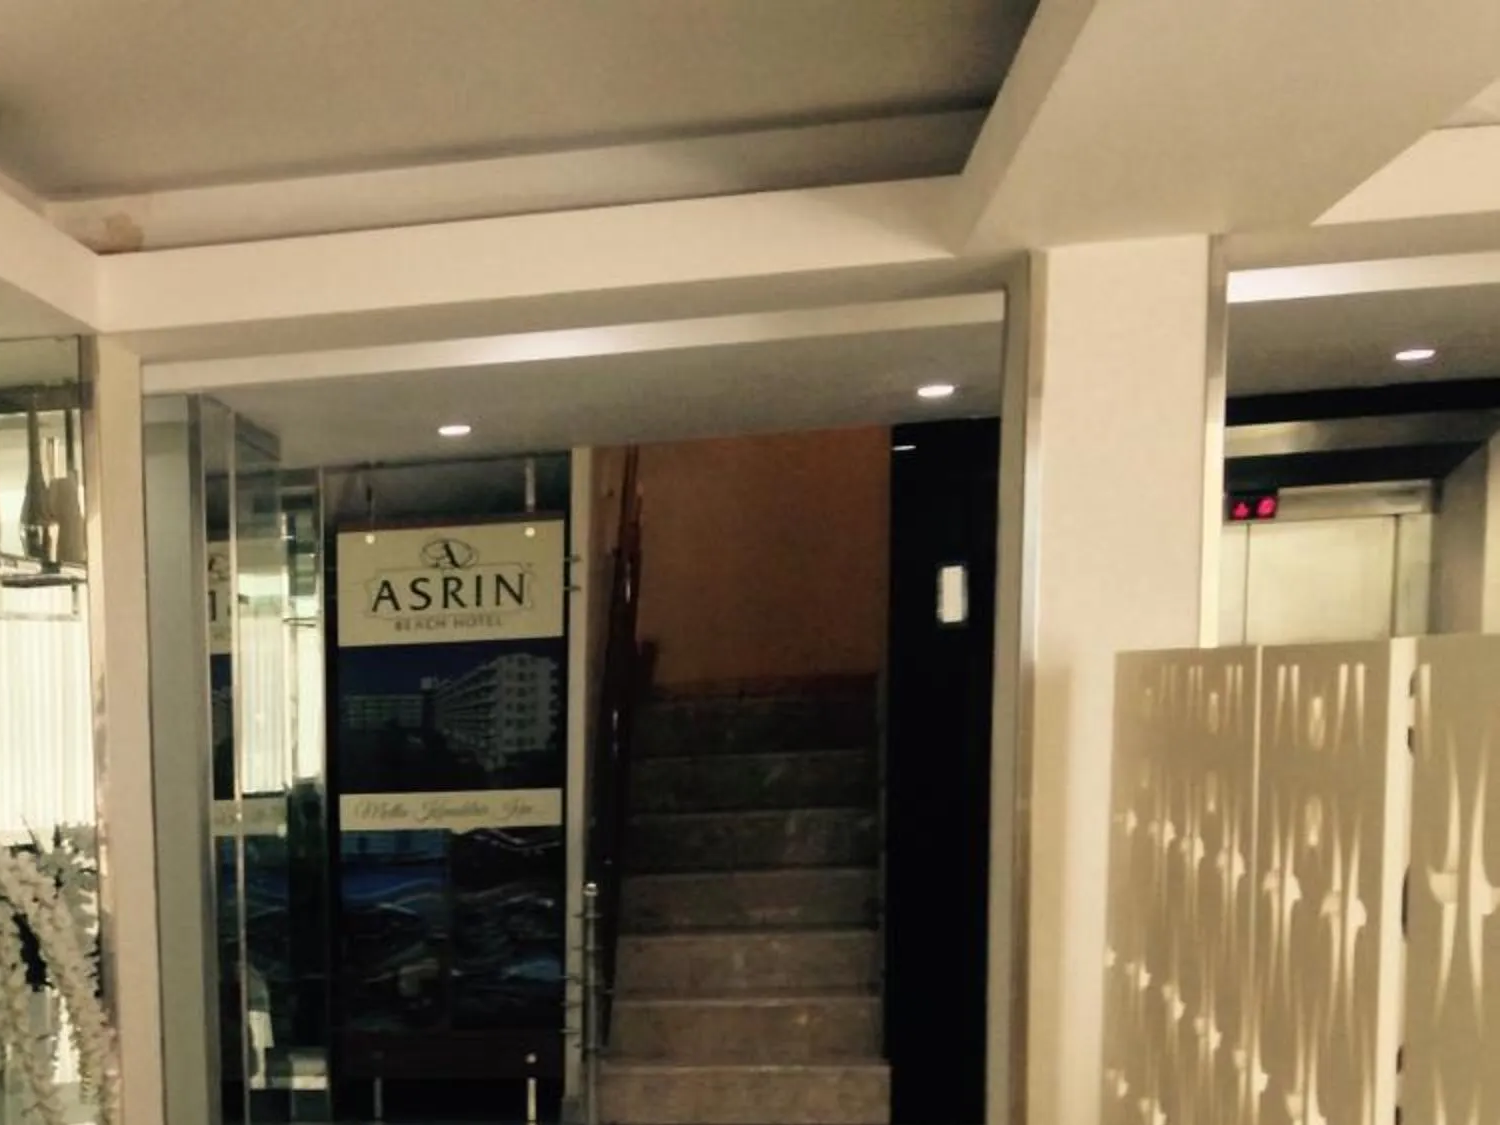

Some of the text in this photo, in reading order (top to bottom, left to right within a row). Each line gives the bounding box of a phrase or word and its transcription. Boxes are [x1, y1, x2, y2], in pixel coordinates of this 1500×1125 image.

[371, 573, 525, 612] ASRIN
[394, 613, 503, 632] BEACH HOTEL
